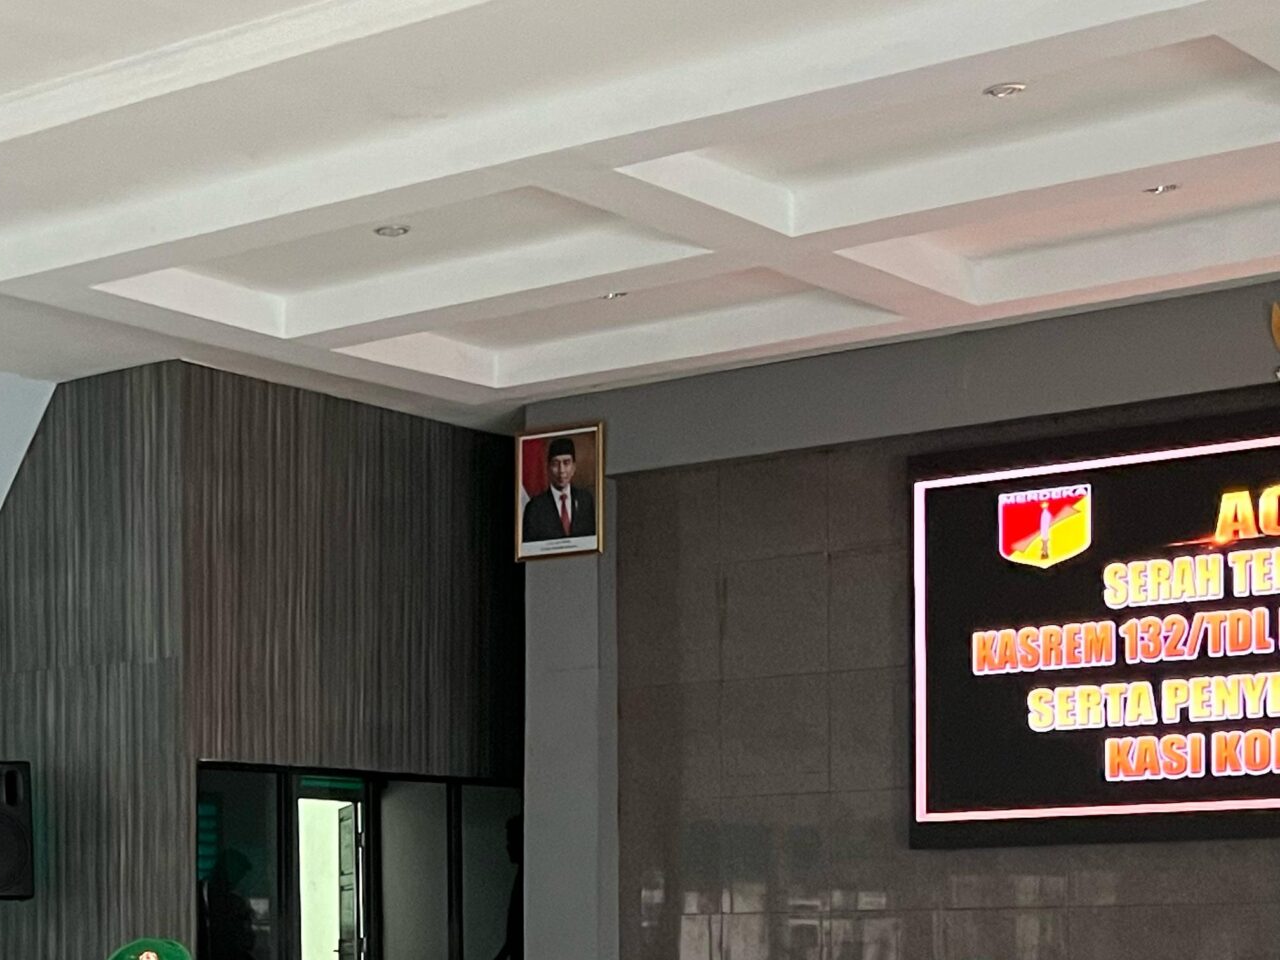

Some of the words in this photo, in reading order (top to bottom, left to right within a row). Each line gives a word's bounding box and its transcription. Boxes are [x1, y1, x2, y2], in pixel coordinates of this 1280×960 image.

[1103, 553, 1224, 609] SERAH
[1227, 546, 1280, 598] TE
[972, 620, 1116, 676] KASREM
[1119, 607, 1274, 665] 132/TDL
[1026, 681, 1158, 732] SERTA
[1105, 733, 1205, 782] KASI
